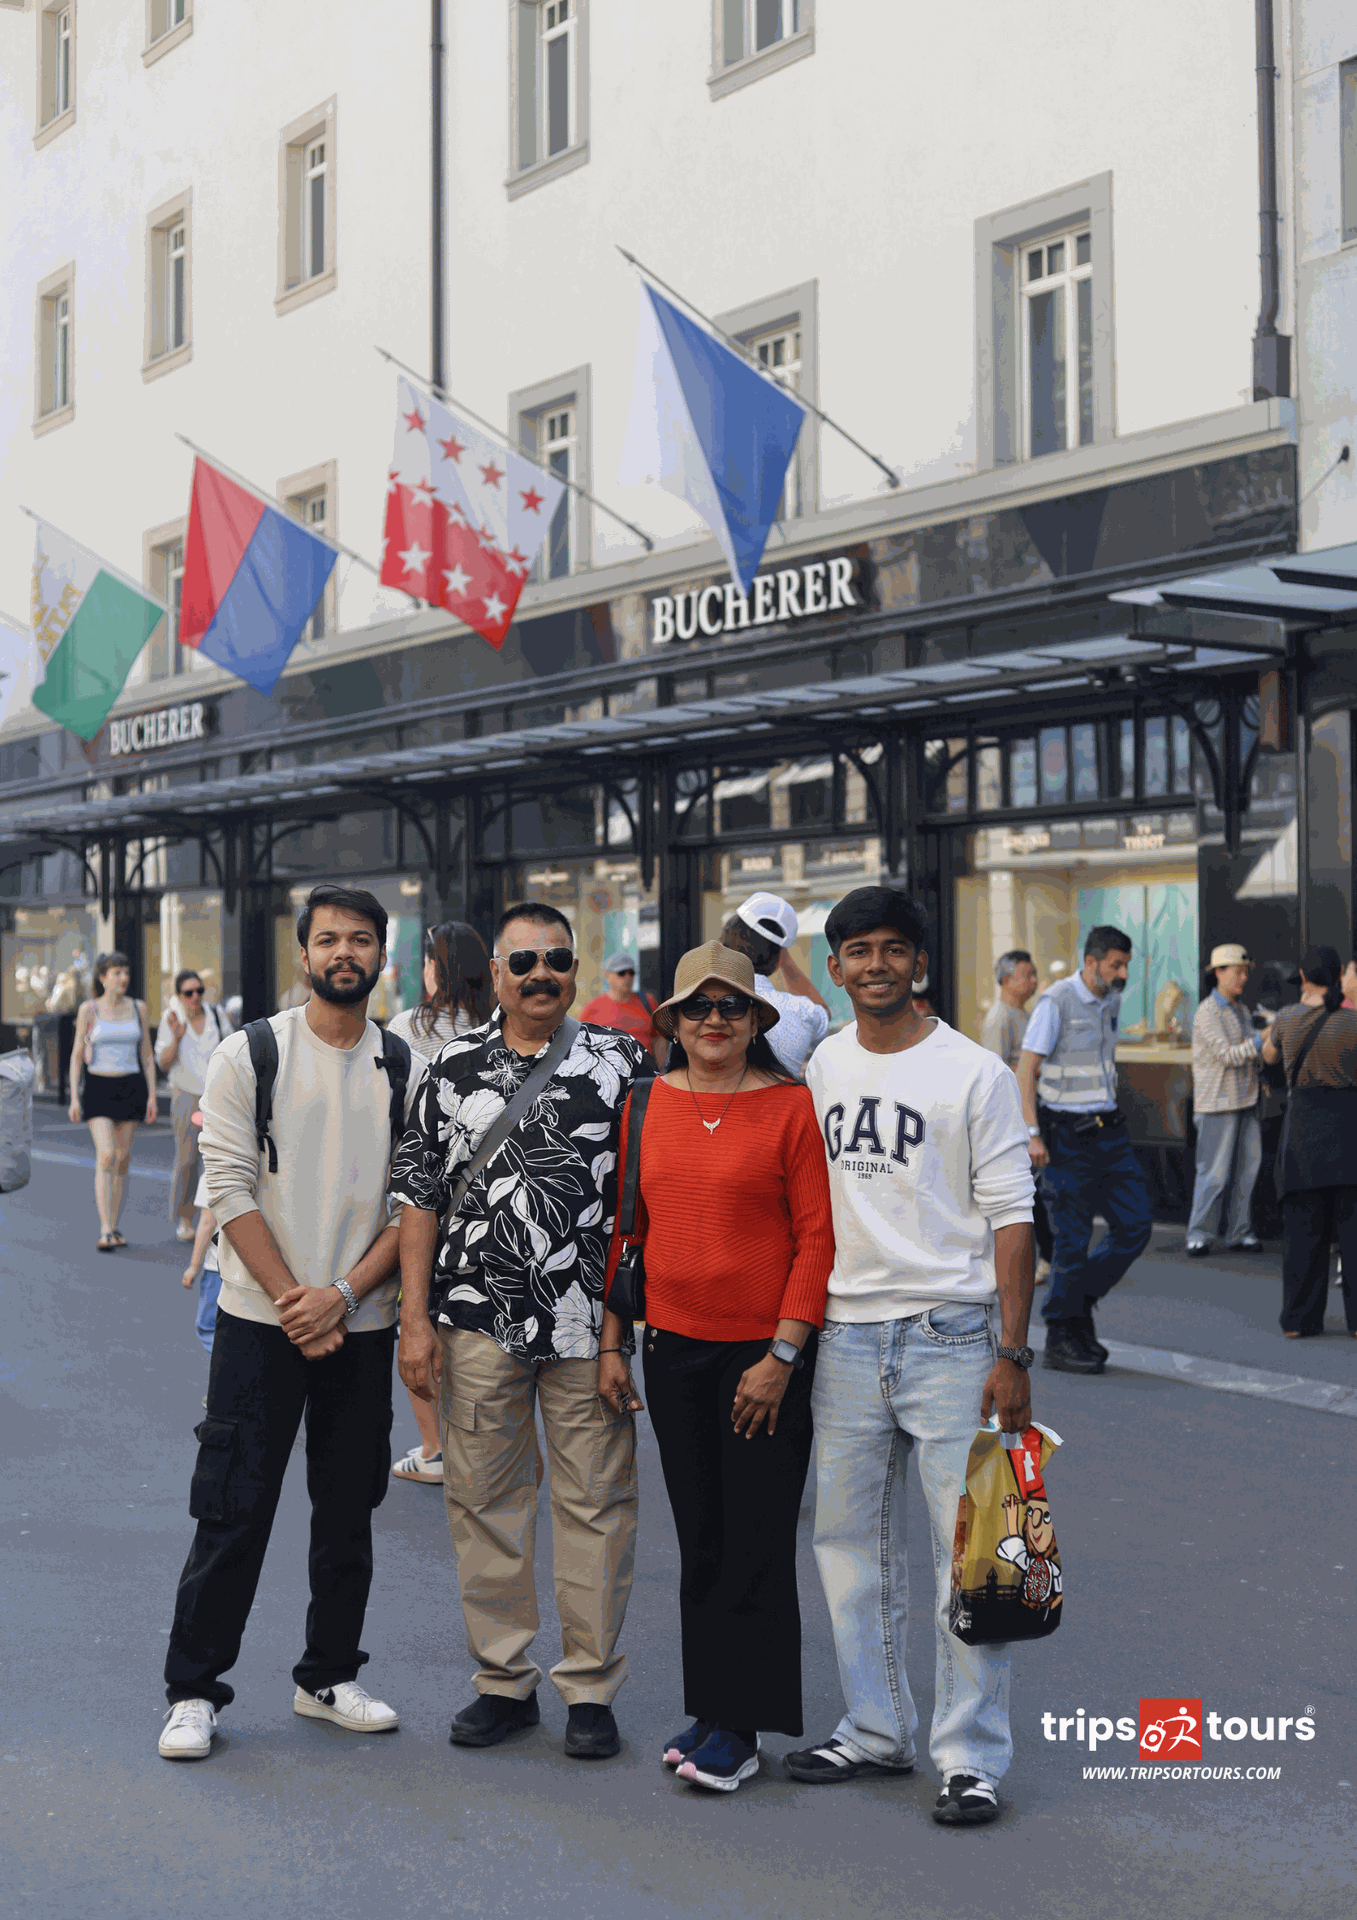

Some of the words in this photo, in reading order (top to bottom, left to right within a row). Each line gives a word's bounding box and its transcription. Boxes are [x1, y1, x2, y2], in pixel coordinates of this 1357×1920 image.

[652, 557, 857, 644] BUCHERER
[110, 702, 204, 755] BUCHERER
[824, 1096, 926, 1167] GAP
